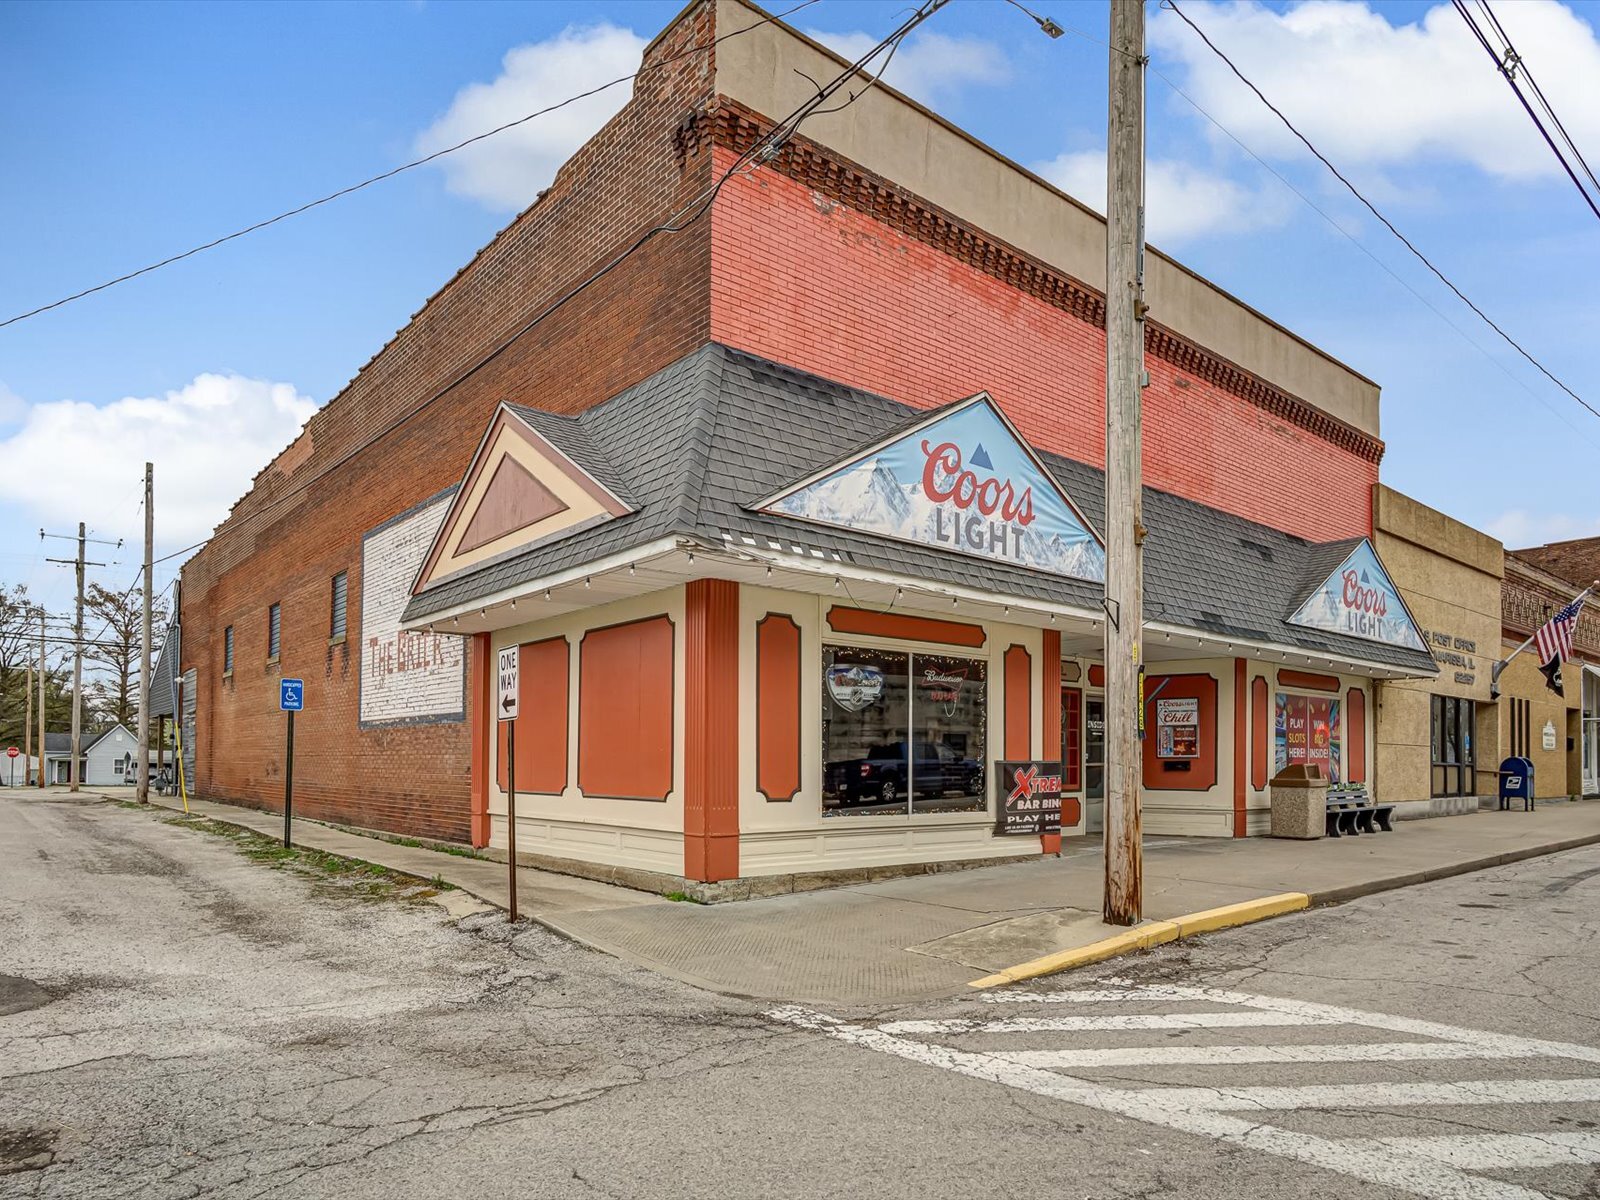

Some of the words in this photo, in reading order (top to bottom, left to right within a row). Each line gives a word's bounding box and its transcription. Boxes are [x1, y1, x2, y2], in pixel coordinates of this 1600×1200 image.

[921, 439, 1036, 527] Coors
[936, 508, 1025, 559] LIGHT
[1342, 570, 1387, 617] Coors
[1348, 611, 1383, 638] LIGHT
[1432, 631, 1452, 647] POST
[370, 637, 393, 677] THE
[500, 651, 516, 671] ONE
[500, 672, 517, 691] WAY
[924, 669, 963, 683] Budweiser
[1163, 712, 1193, 723] Chill
[1289, 718, 1304, 729] PLAY
[1313, 720, 1325, 730] WIN
[1288, 732, 1306, 743] SLOTS
[1288, 747, 1306, 758] HERE!
[1309, 748, 1329, 759] INSIDE!
[1017, 800, 1040, 810] BAR
[1042, 798, 1061, 809] BIN
[1007, 814, 1040, 823] PLAY
